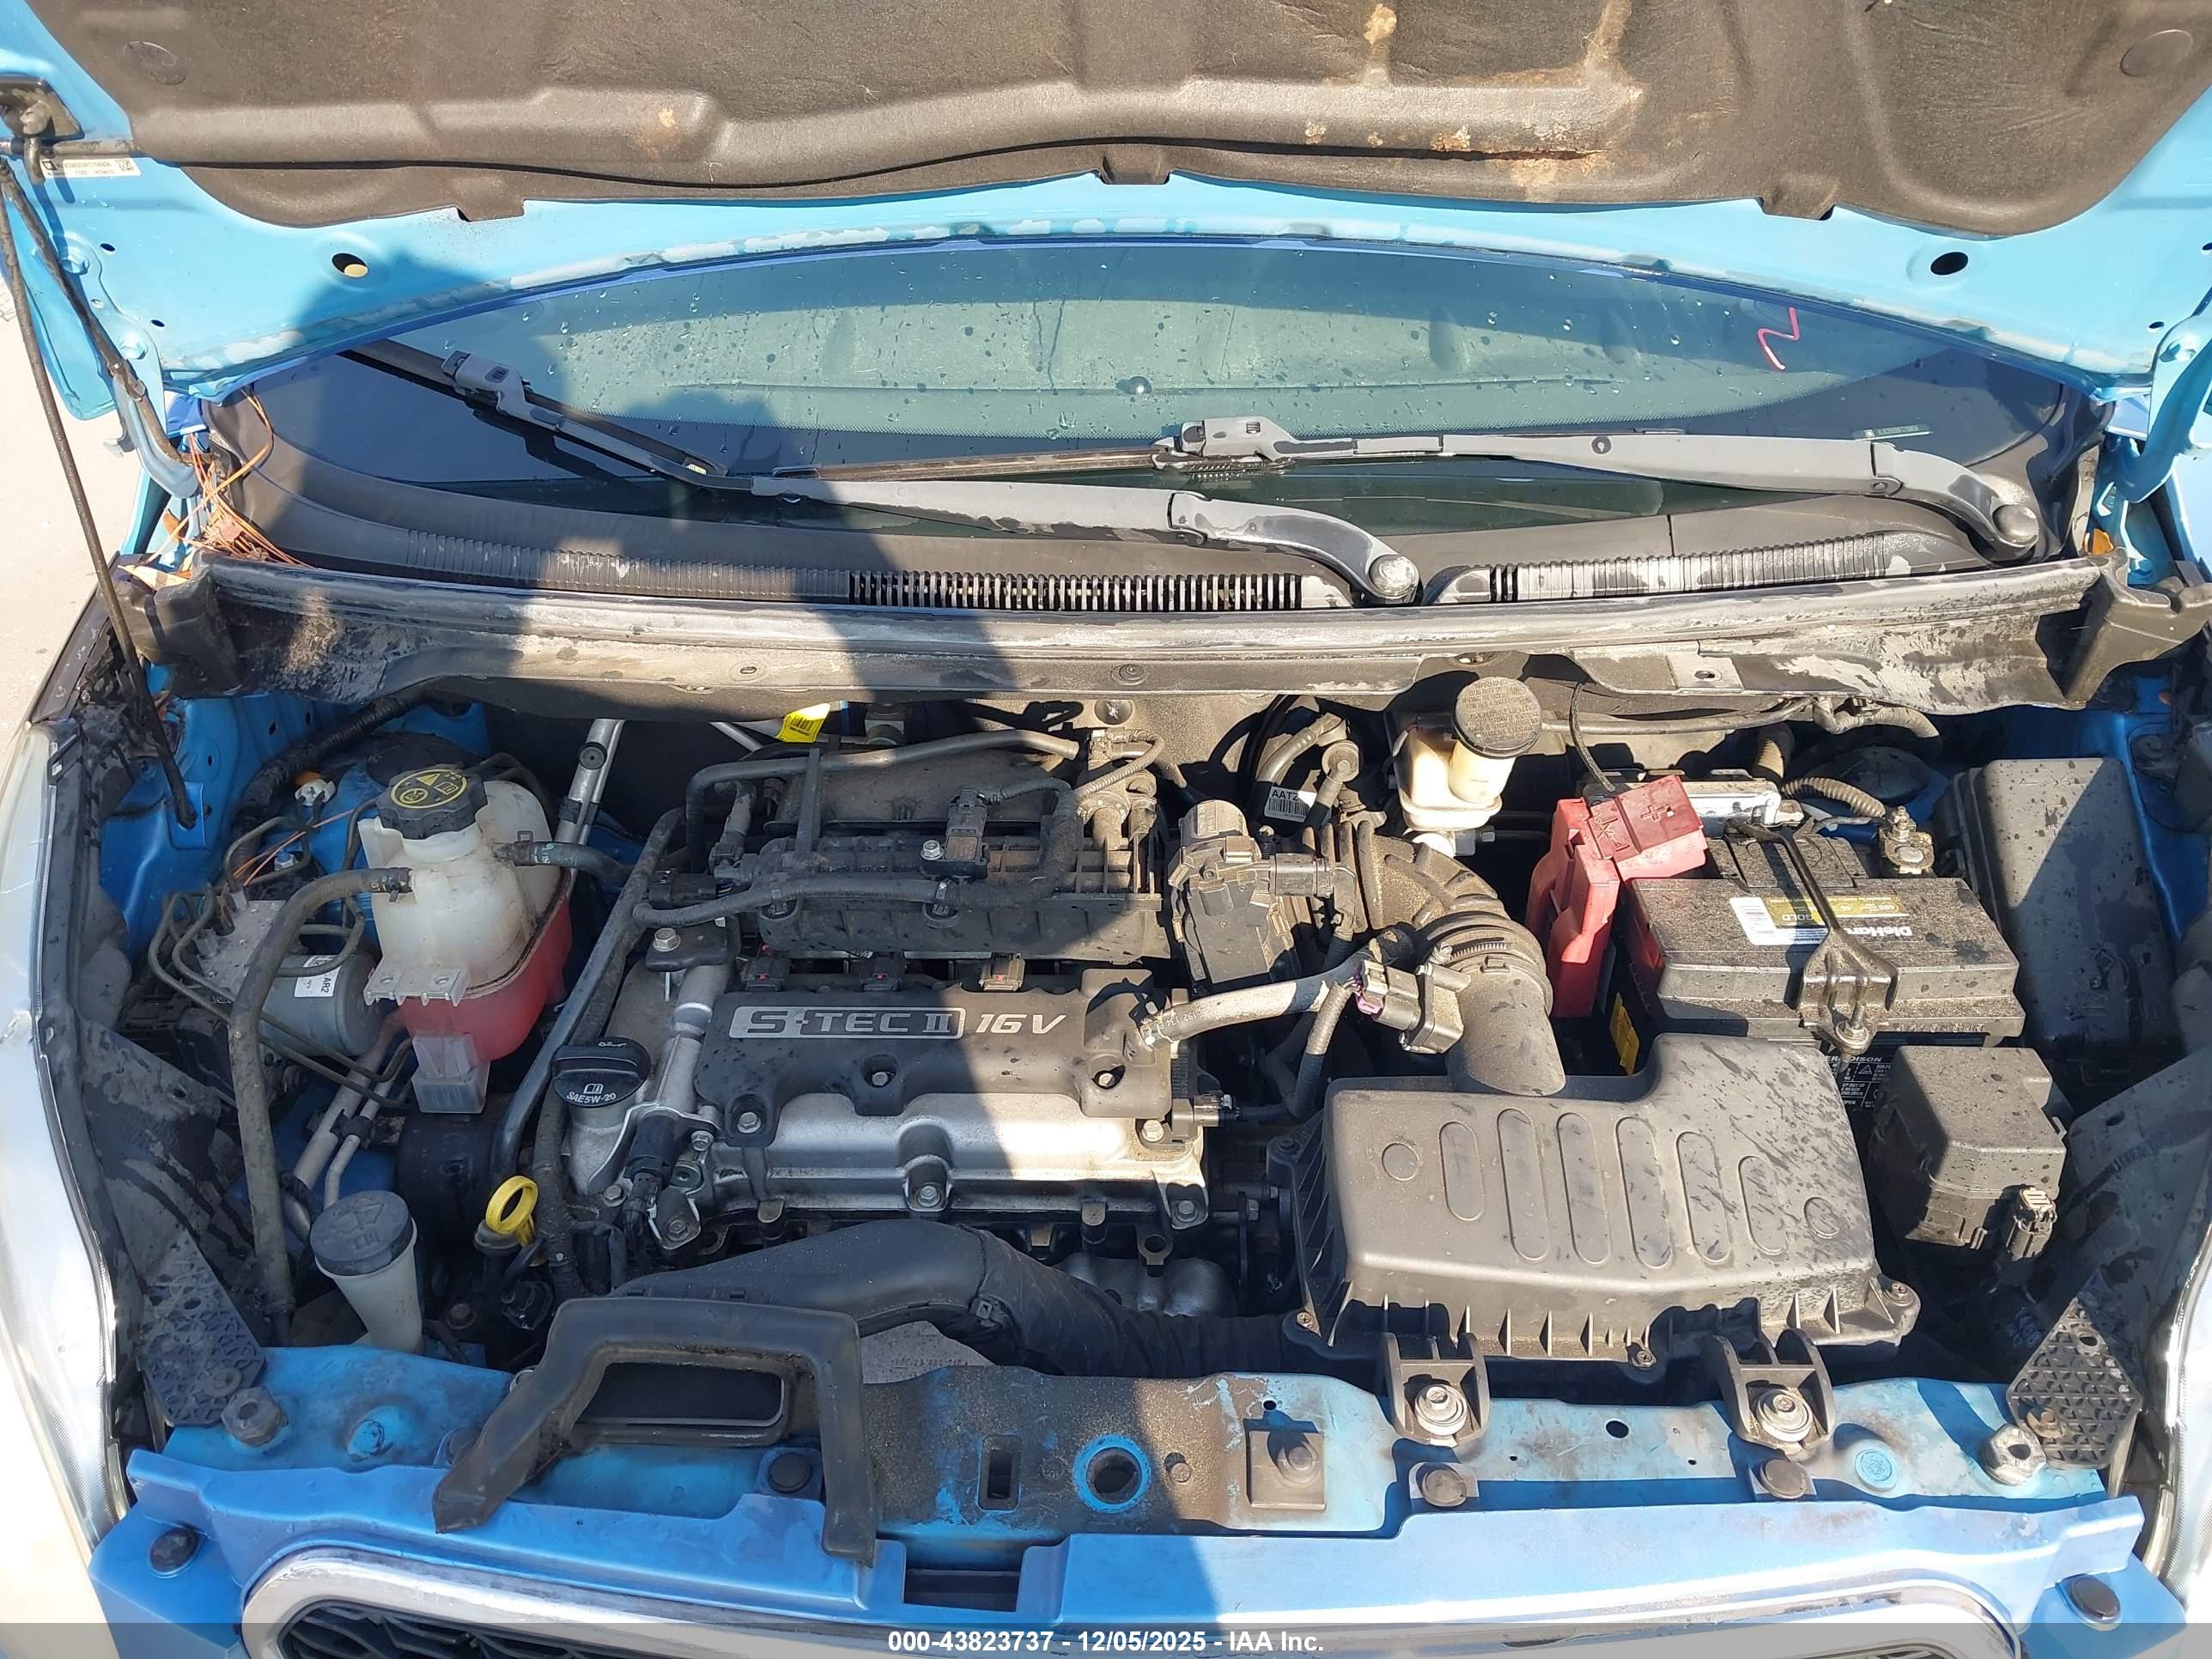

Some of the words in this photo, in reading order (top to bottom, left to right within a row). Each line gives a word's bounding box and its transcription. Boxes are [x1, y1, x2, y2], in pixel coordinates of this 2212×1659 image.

[1846, 926, 1913, 937] DieHar
[321, 977, 331, 994] AR2
[975, 1013, 1066, 1034] 16V
